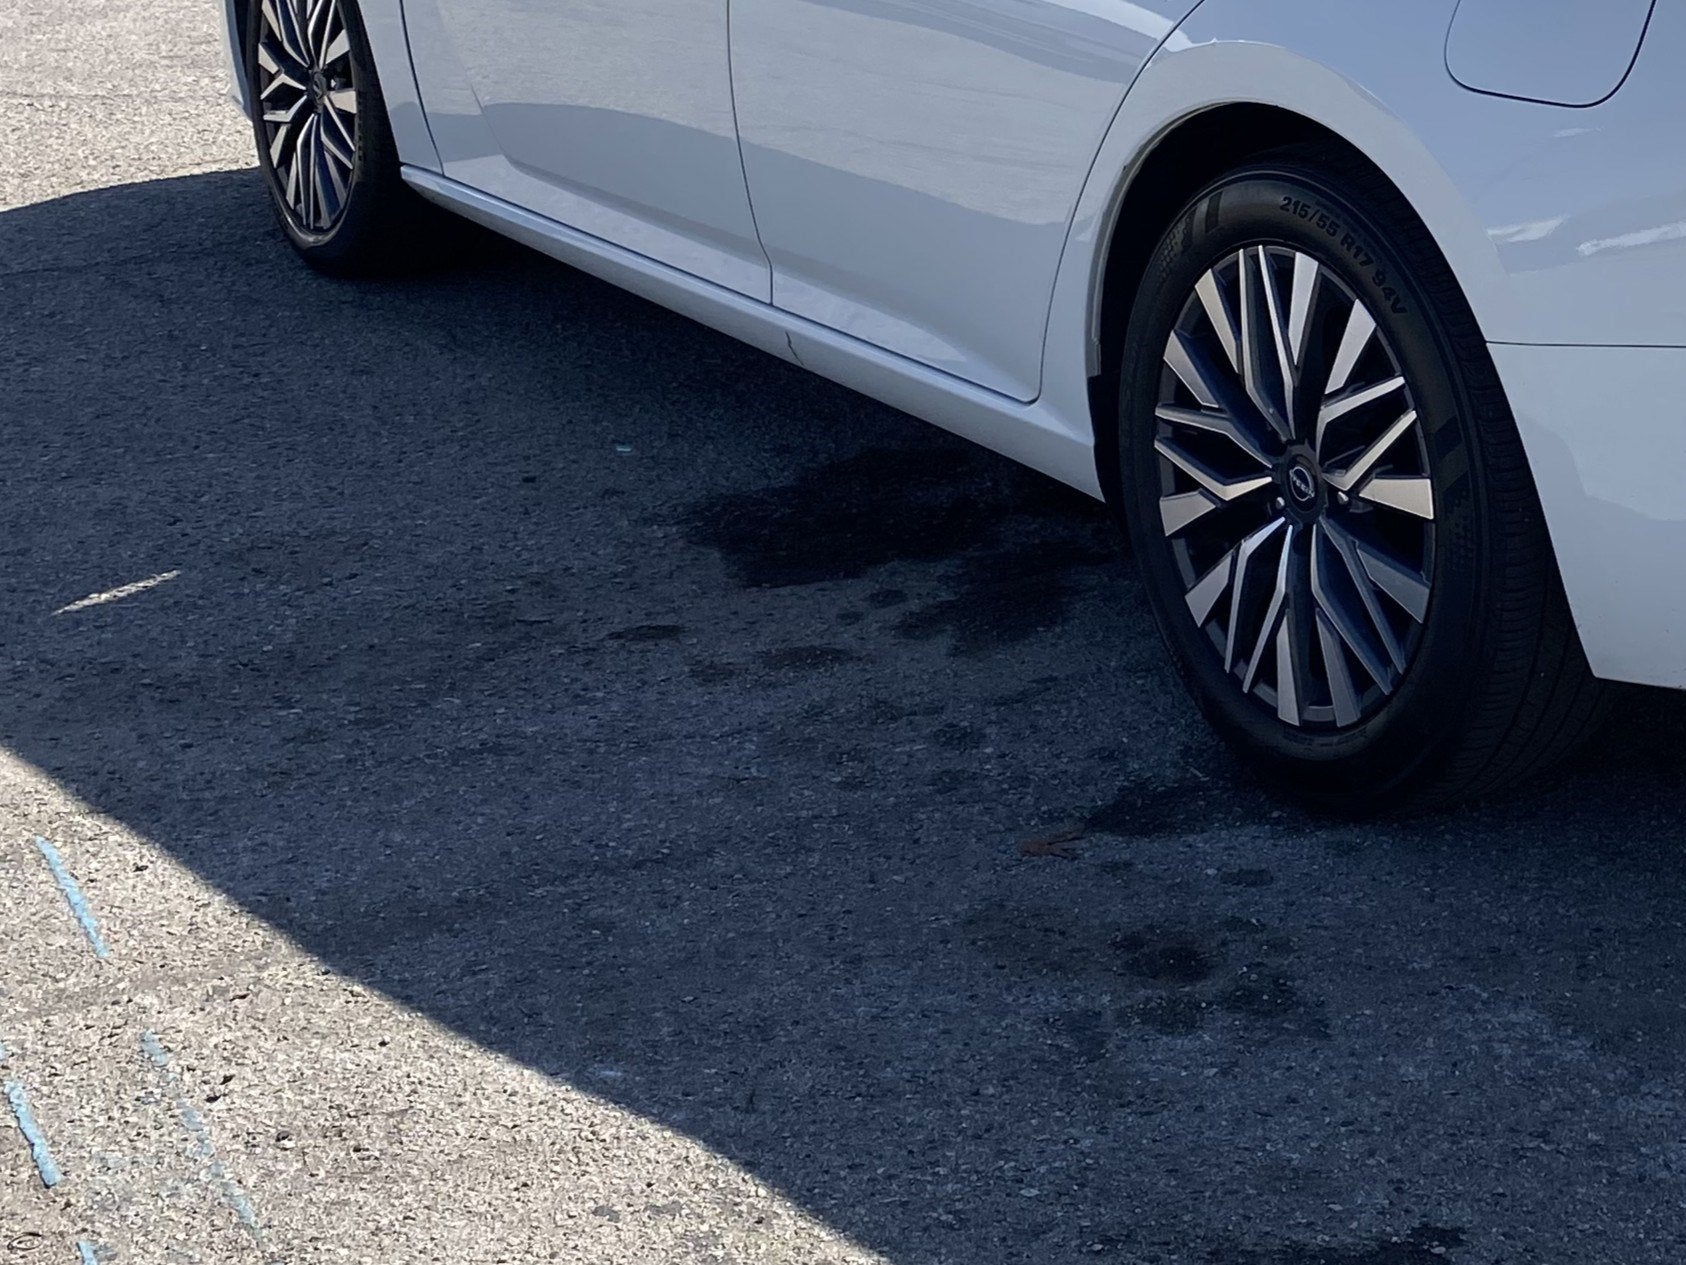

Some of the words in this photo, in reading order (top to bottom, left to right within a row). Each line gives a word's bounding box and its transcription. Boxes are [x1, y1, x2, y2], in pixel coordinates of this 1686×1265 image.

[1280, 196, 1341, 237] 215/55
[1341, 233, 1374, 267] R17
[1372, 269, 1408, 314] 94V
